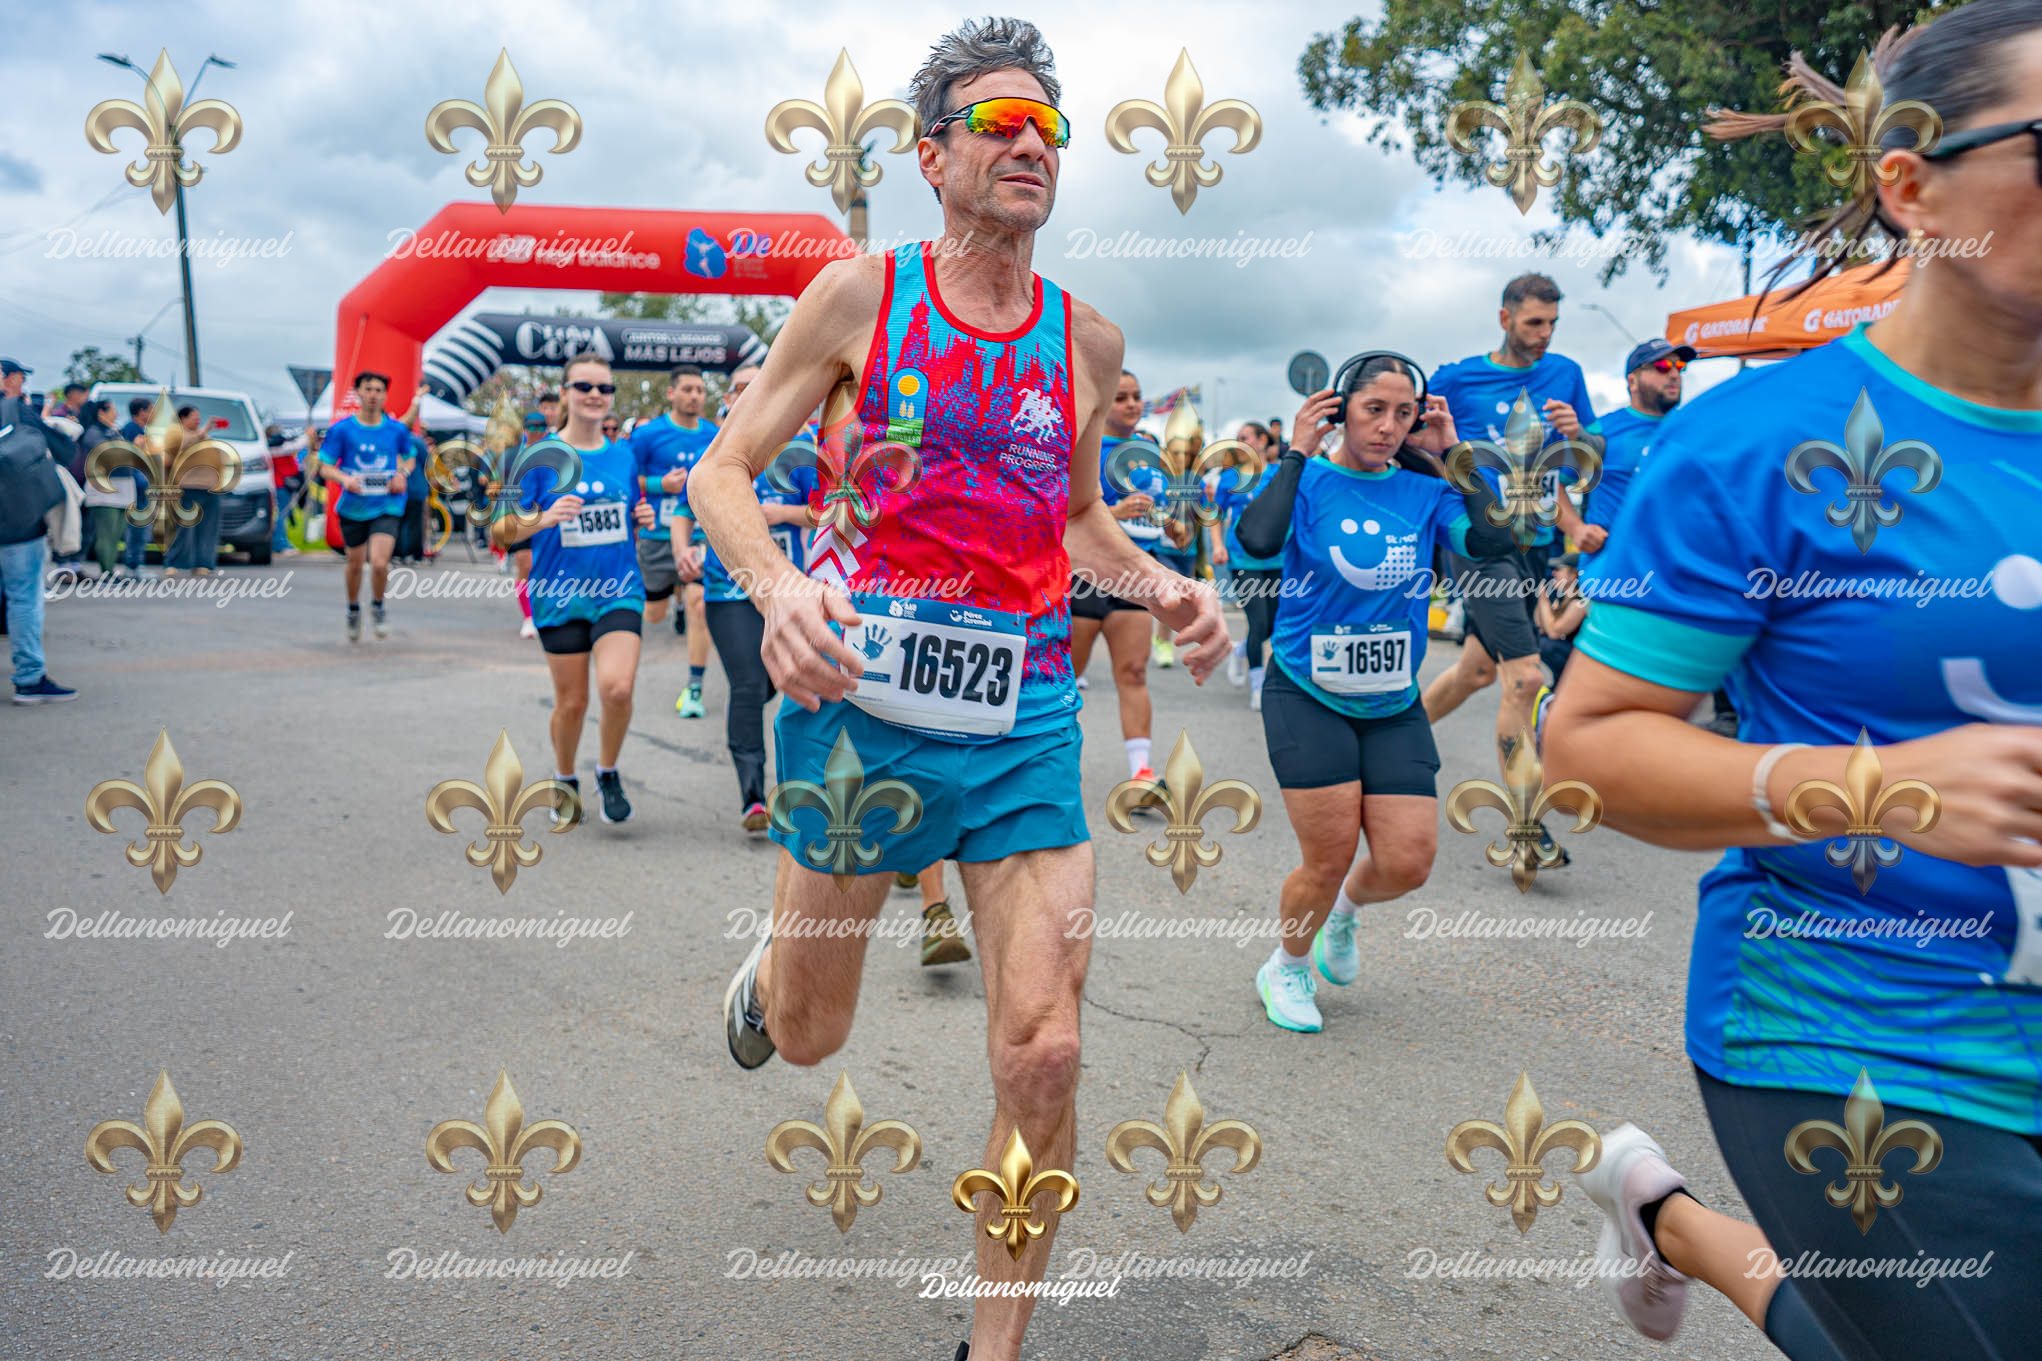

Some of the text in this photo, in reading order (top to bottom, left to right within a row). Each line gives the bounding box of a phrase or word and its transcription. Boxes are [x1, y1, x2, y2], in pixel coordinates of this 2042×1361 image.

[669, 346, 727, 364] LEJOS
[1008, 443, 1057, 463] RUNNING
[579, 508, 621, 534] 15883
[1345, 637, 1407, 675] 16597
[899, 632, 1013, 707] 16523
